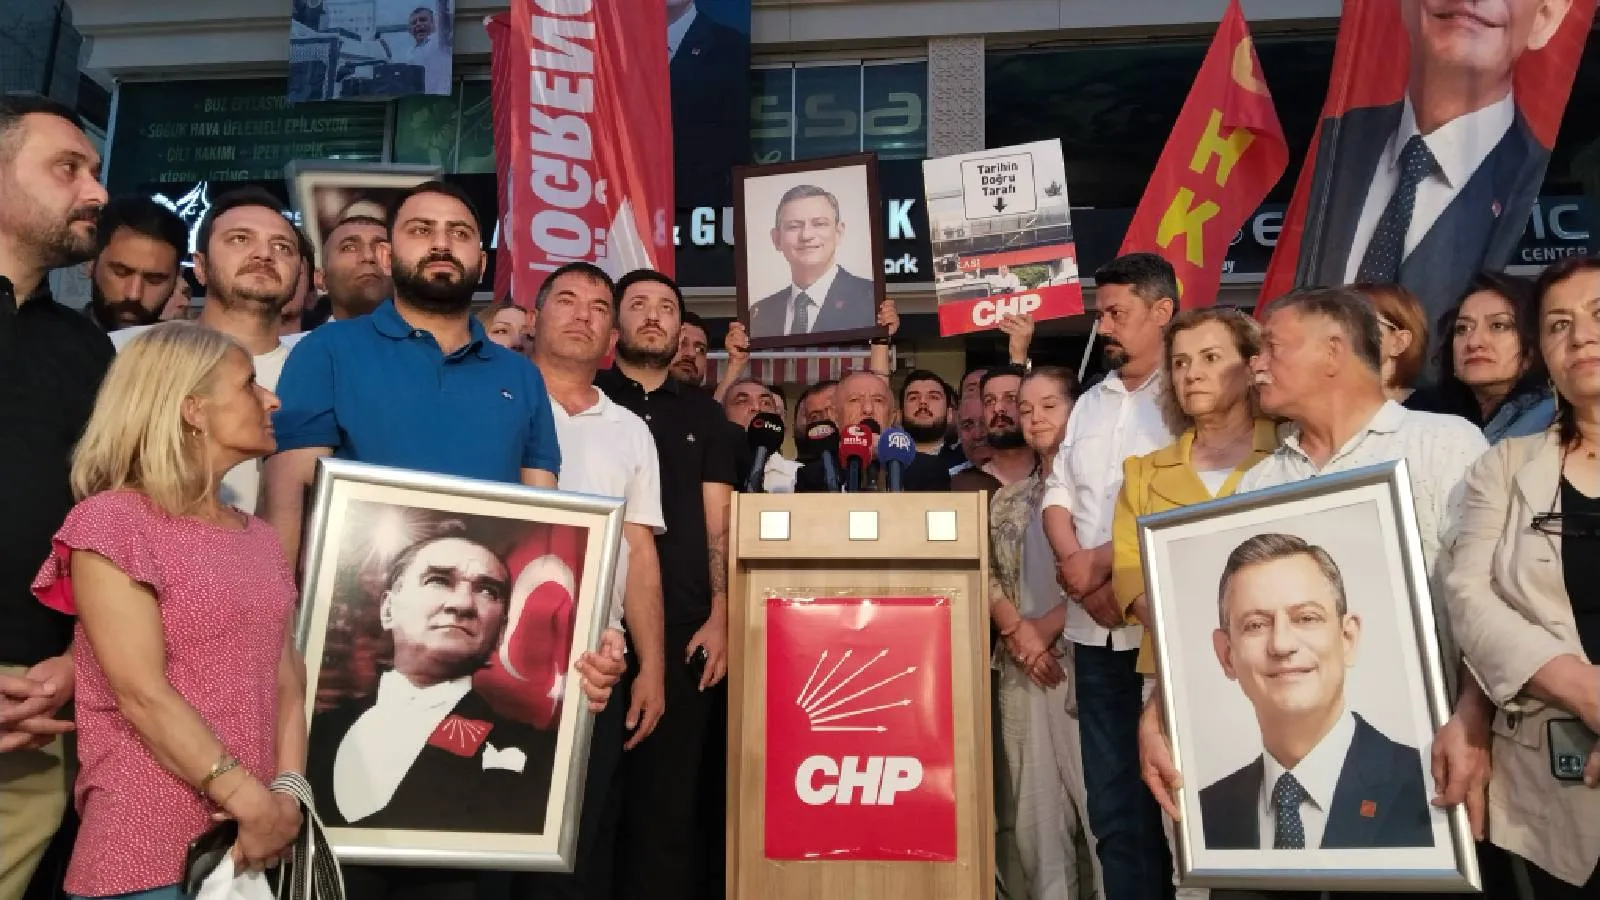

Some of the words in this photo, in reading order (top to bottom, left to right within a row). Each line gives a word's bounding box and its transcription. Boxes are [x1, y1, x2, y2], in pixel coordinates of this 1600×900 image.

[190, 120, 219, 136] HAVA
[976, 161, 1019, 174] Tarihin
[981, 173, 1016, 185] Doğru
[981, 184, 1016, 196] Tarafı
[1521, 246, 1588, 262] CENTER
[972, 293, 1042, 327] CHP
[795, 754, 923, 806] CHP
